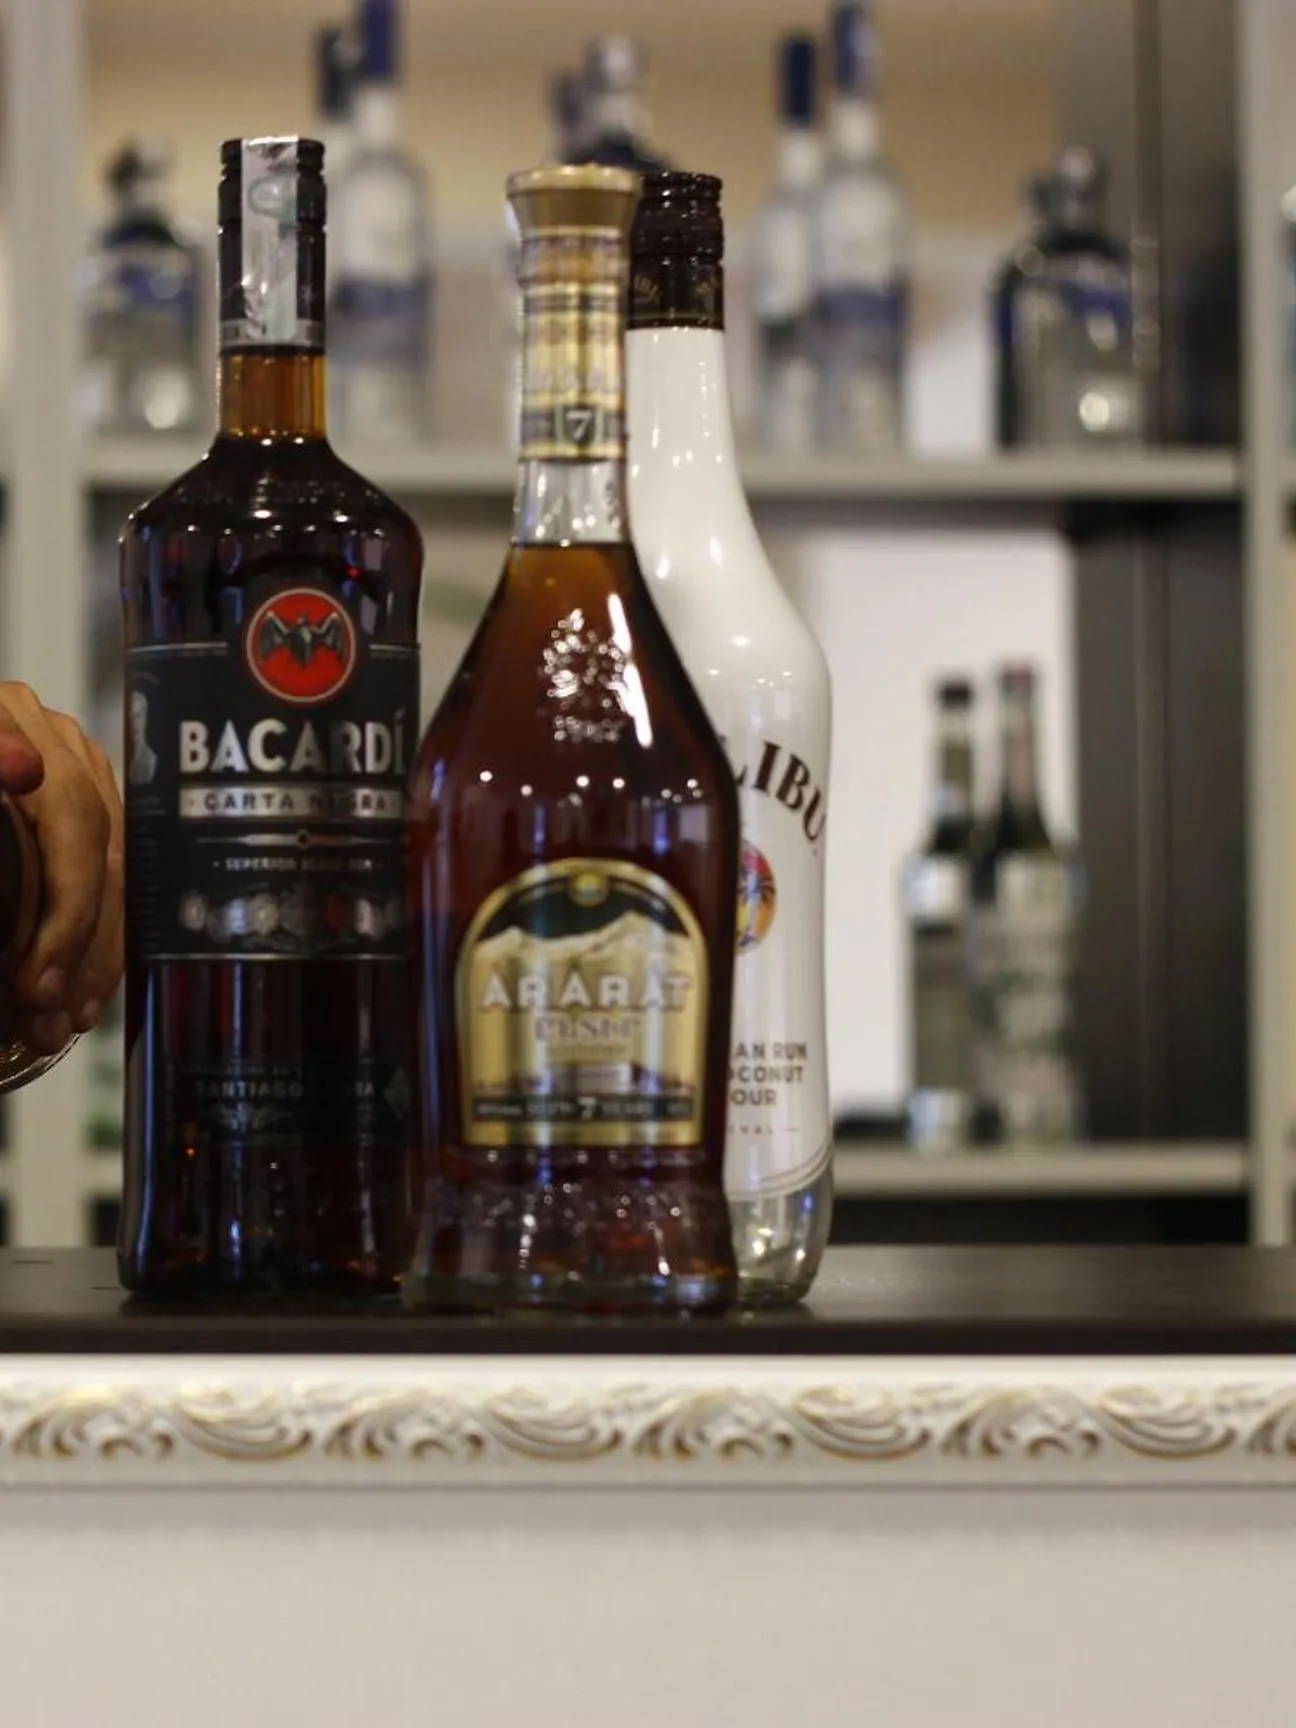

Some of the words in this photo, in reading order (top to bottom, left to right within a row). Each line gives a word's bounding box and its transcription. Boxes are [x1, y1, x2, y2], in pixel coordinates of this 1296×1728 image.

[566, 410, 592, 439] 7
[179, 704, 406, 774] BACARDÍ
[204, 793, 294, 811] CARTA
[480, 966, 692, 1007] ARARAT
[578, 1097, 596, 1118] 7
